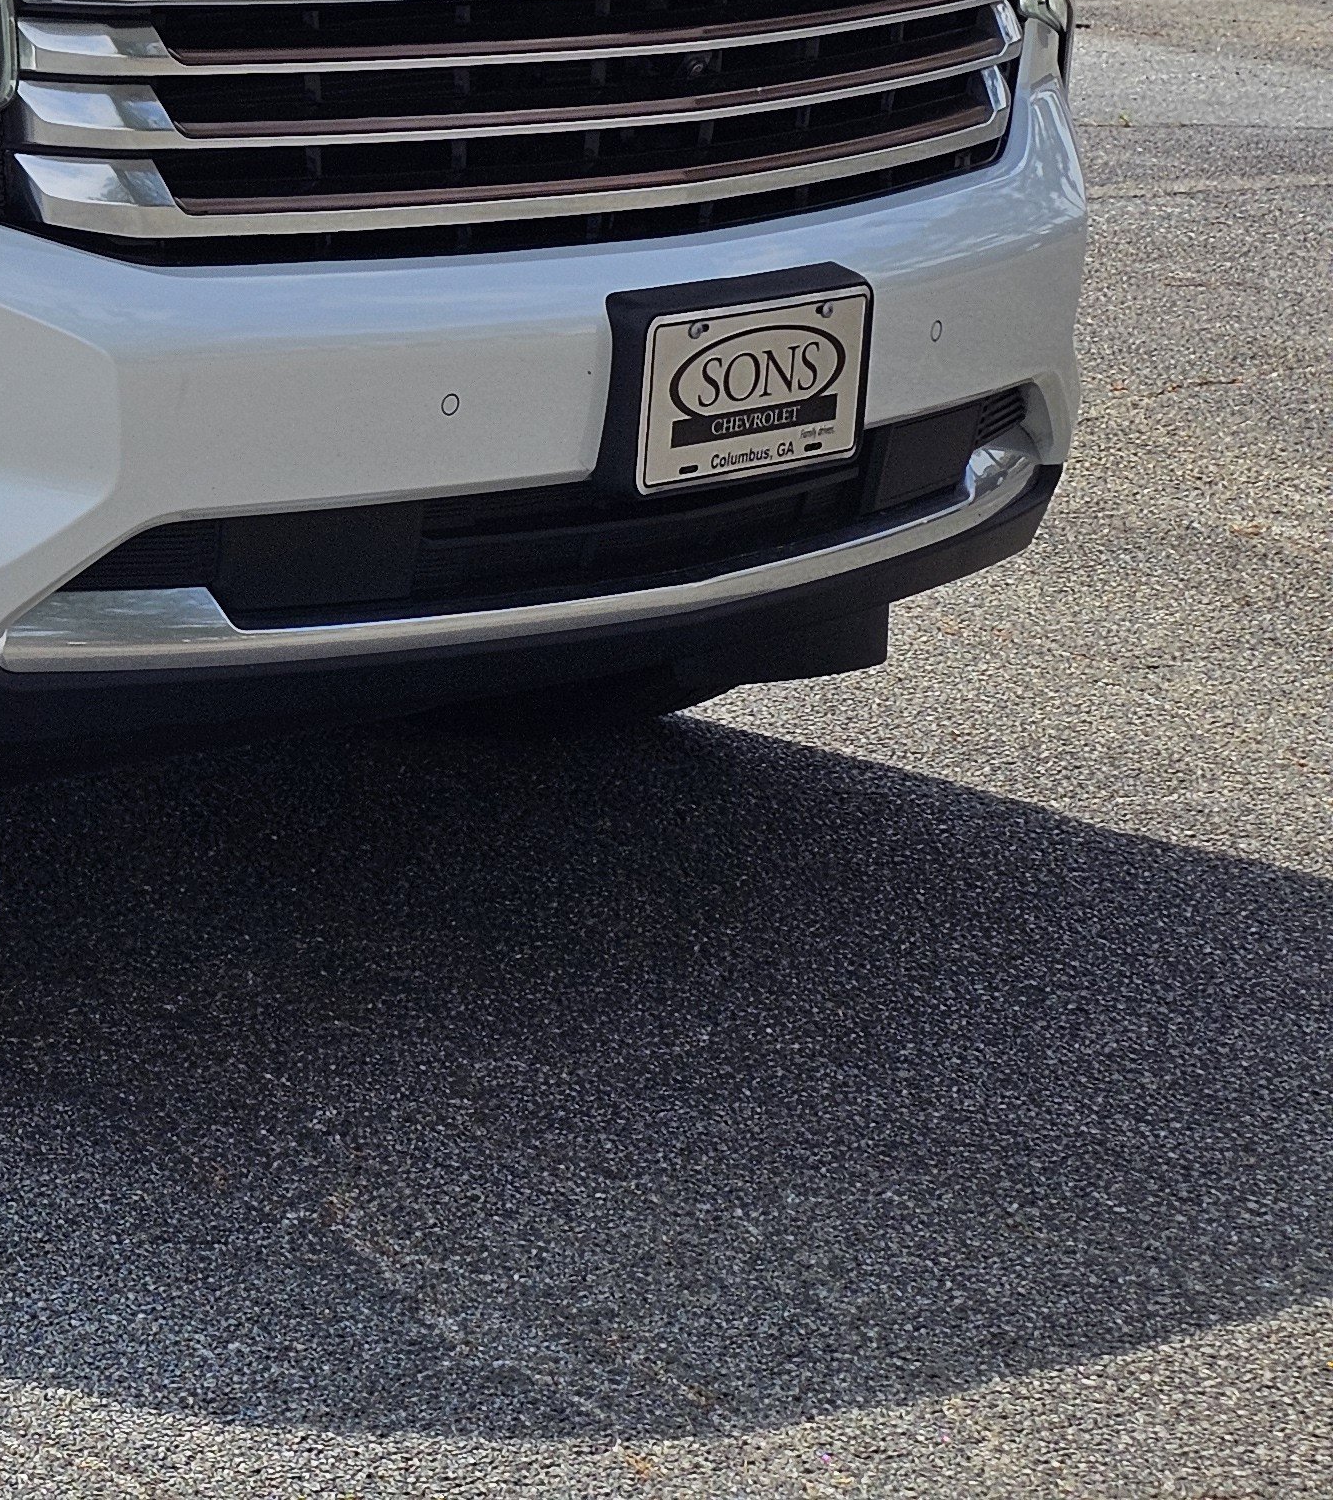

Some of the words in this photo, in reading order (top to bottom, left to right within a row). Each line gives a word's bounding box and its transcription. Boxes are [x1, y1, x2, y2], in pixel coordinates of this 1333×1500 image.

[697, 341, 820, 408] SONS
[710, 406, 801, 436] CHEVROLET
[710, 450, 773, 469] Columbus,
[776, 440, 794, 457] GA
